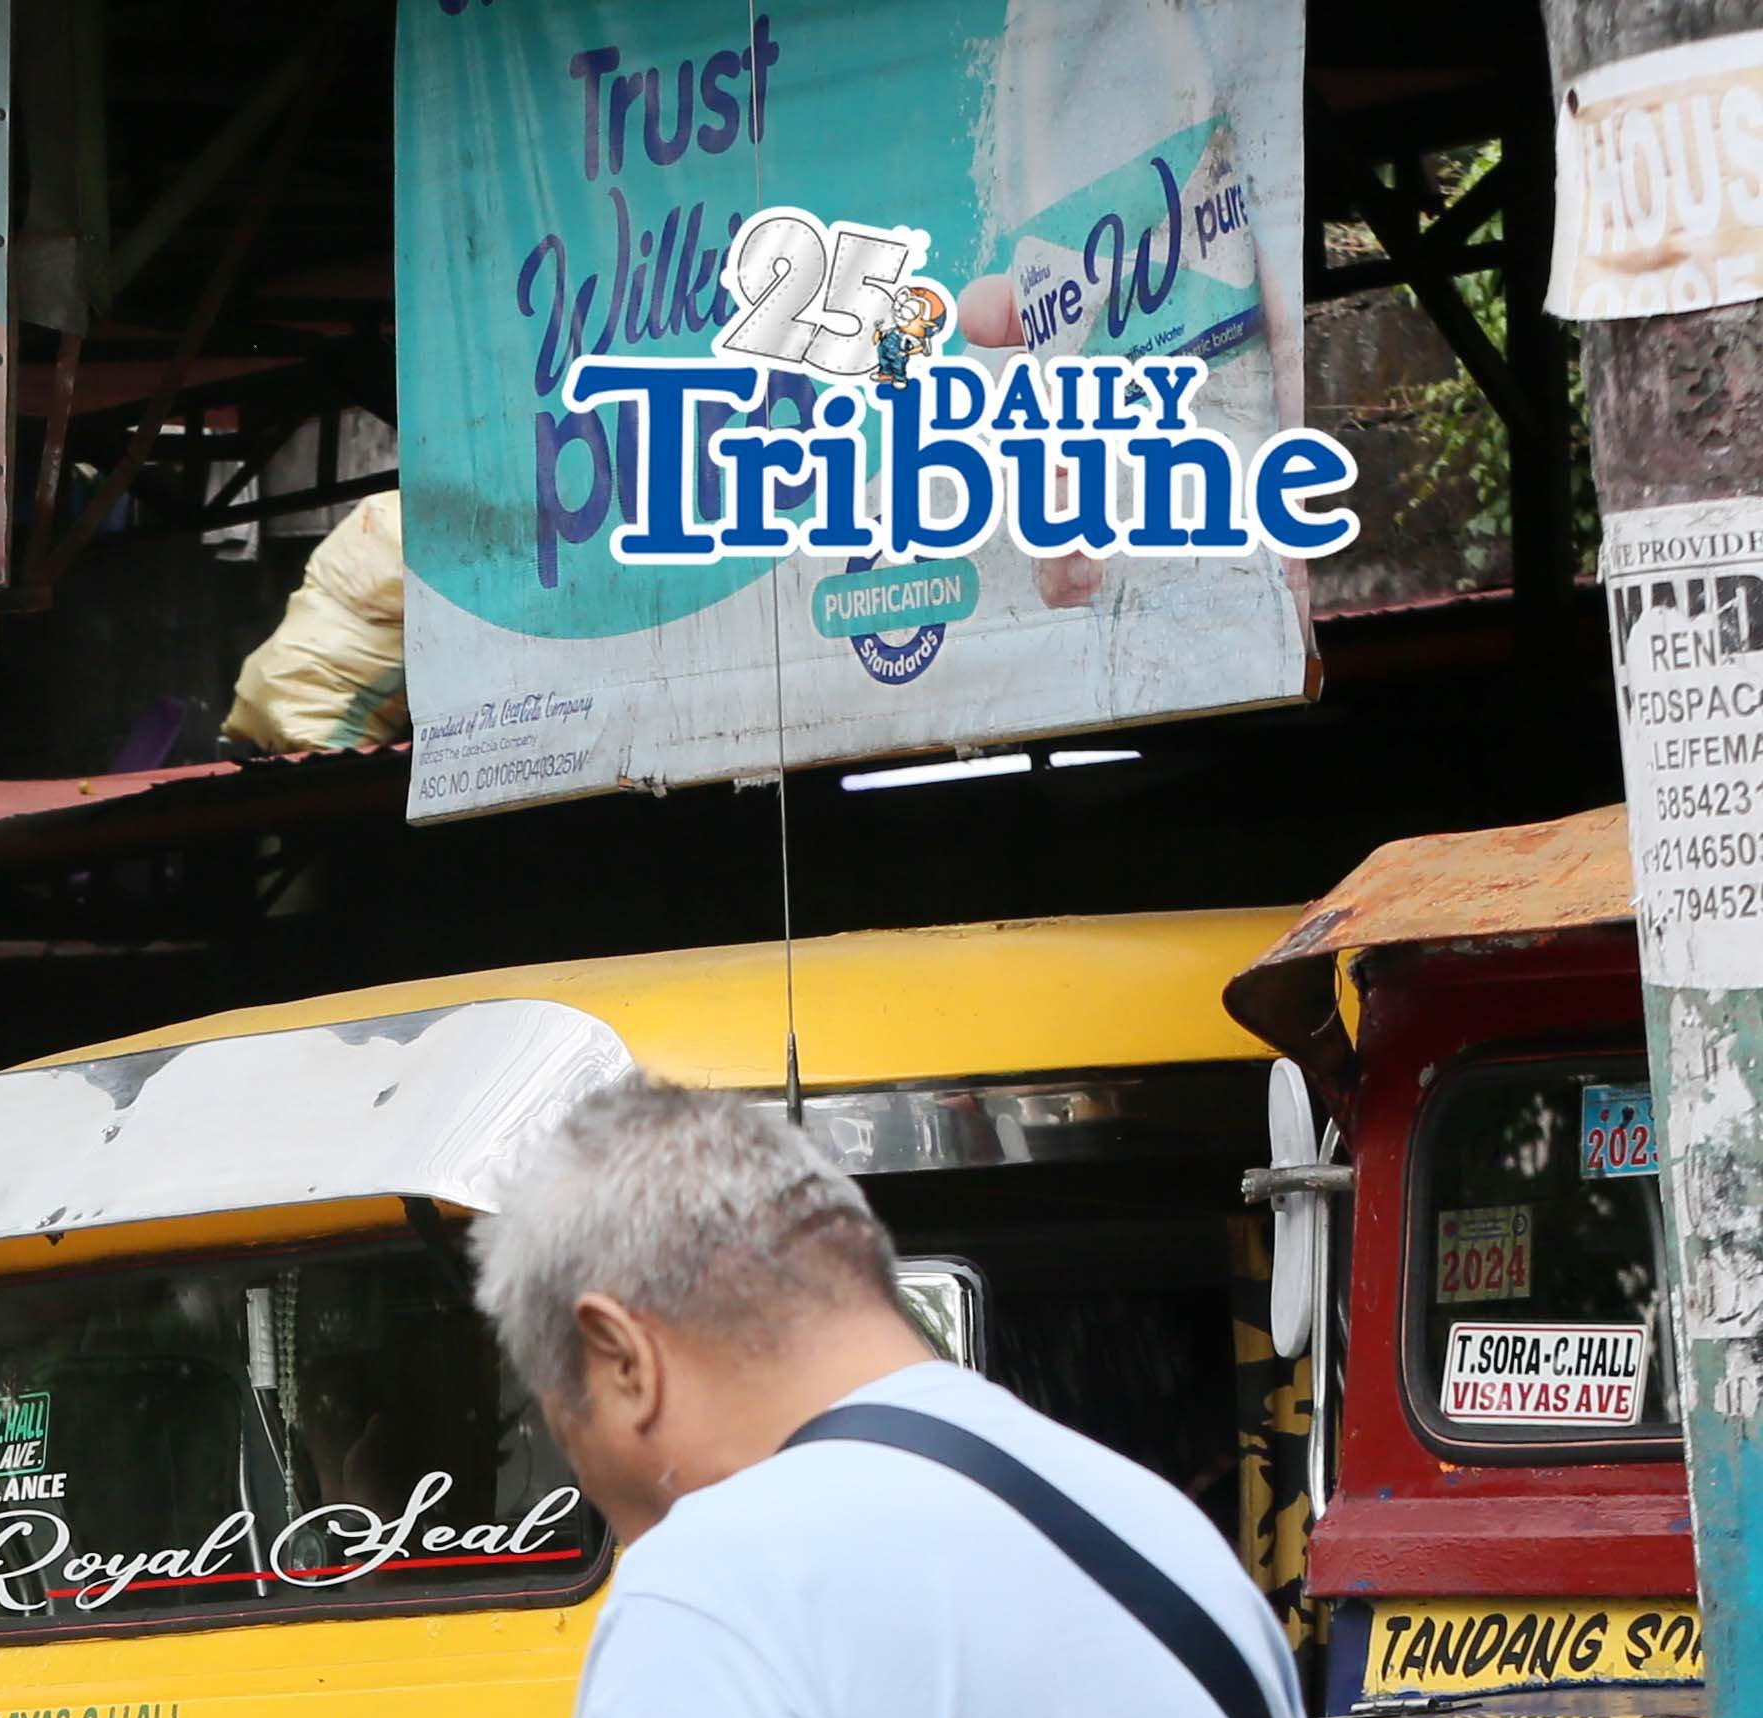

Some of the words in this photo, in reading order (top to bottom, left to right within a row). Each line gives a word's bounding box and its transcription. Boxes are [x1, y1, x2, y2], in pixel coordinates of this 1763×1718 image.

[569, 13, 779, 183] Trust
[1084, 157, 1182, 338] W
[516, 189, 739, 395] Wilki
[824, 575, 961, 619] PURIFICATION
[859, 628, 939, 679] Standards
[1651, 628, 1717, 672] REN
[426, 717, 466, 748] product
[478, 703, 498, 731] The
[544, 691, 594, 724] Company
[500, 735, 539, 751] Company
[419, 775, 446, 801] ASC
[449, 770, 473, 794] NO.
[1442, 1244, 1527, 1293] 2024
[1451, 1380, 1573, 1414] VISAYAS
[1575, 1378, 1631, 1412] AVE
[269, 1470, 582, 1588] Seal
[1382, 1612, 1608, 1683] TANDANG
[1625, 1612, 1703, 1674] SO
